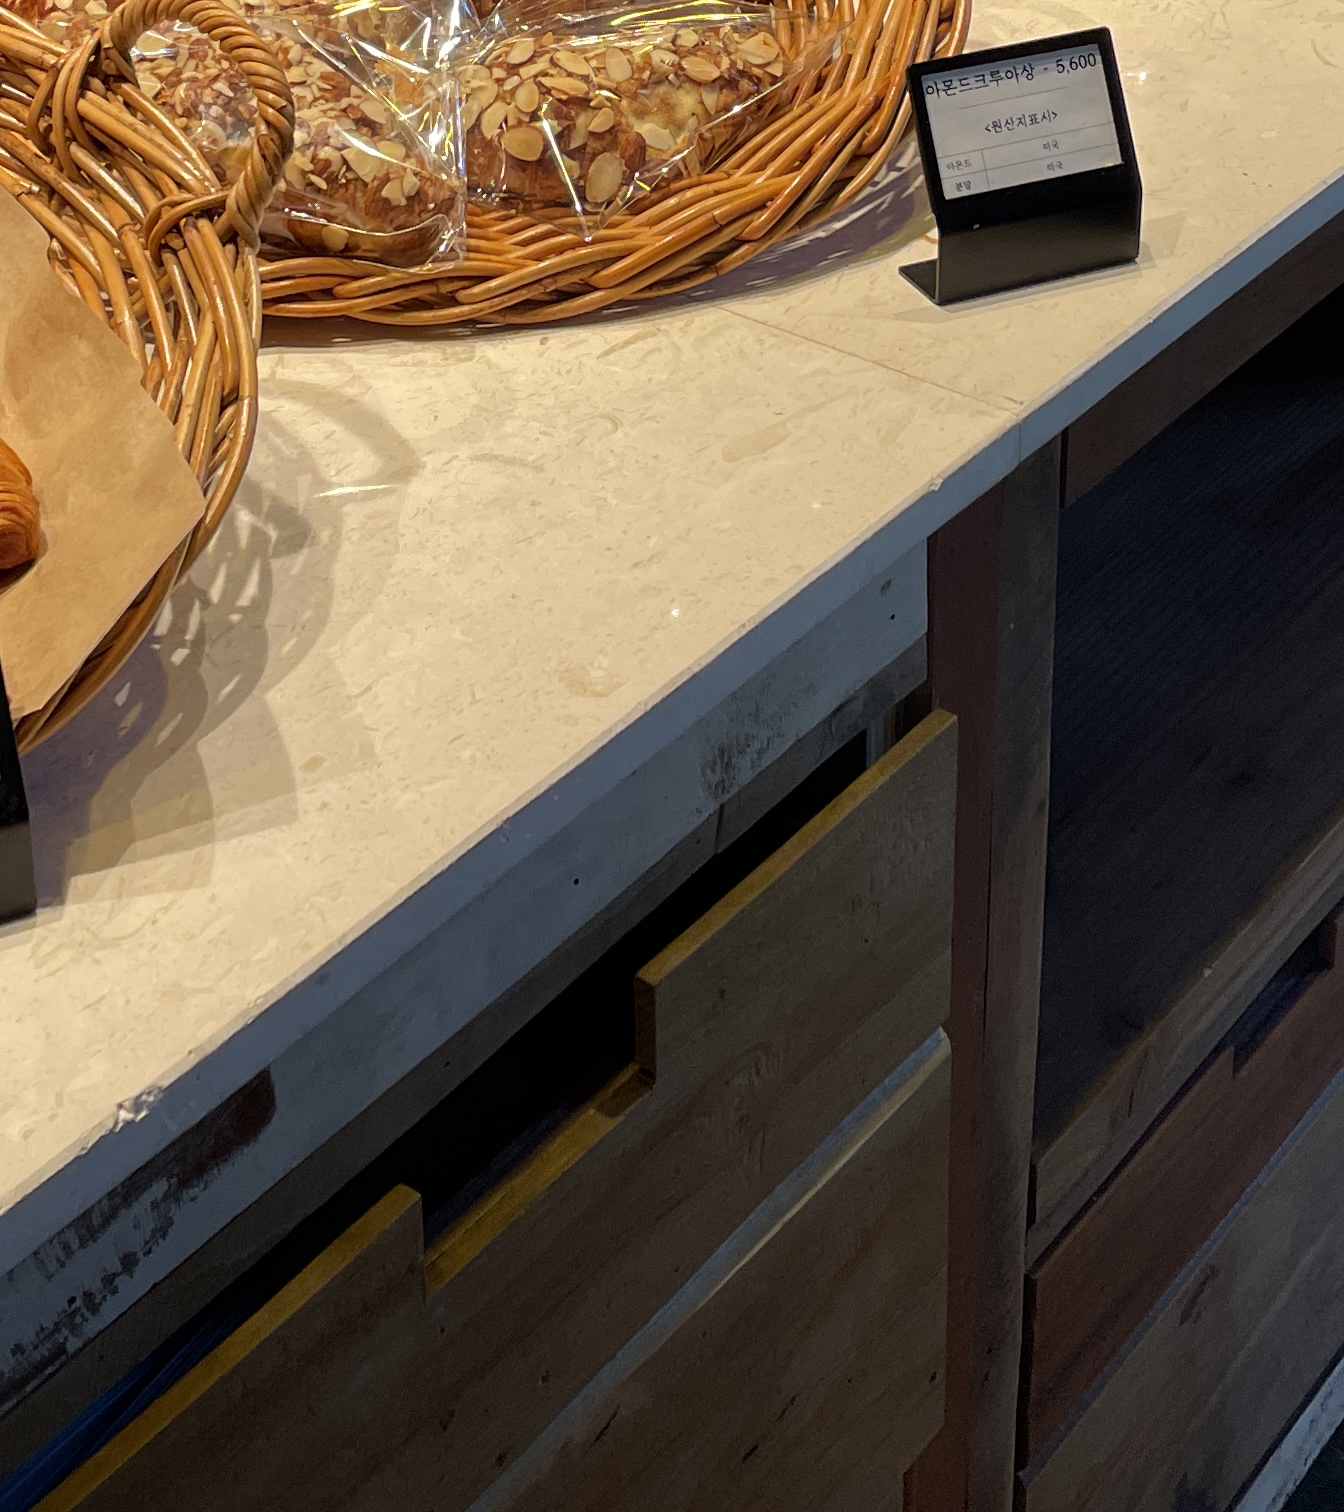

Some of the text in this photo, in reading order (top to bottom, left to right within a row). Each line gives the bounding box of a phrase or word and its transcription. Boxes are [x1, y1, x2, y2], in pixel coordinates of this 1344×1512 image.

[924, 62, 1036, 101] 아몬드크루아상
[1055, 51, 1097, 76] 5,600
[984, 108, 1059, 134] <원산지표시>
[1042, 139, 1060, 152] 미국
[945, 158, 974, 172] 아몬드
[1046, 160, 1064, 173] 미국
